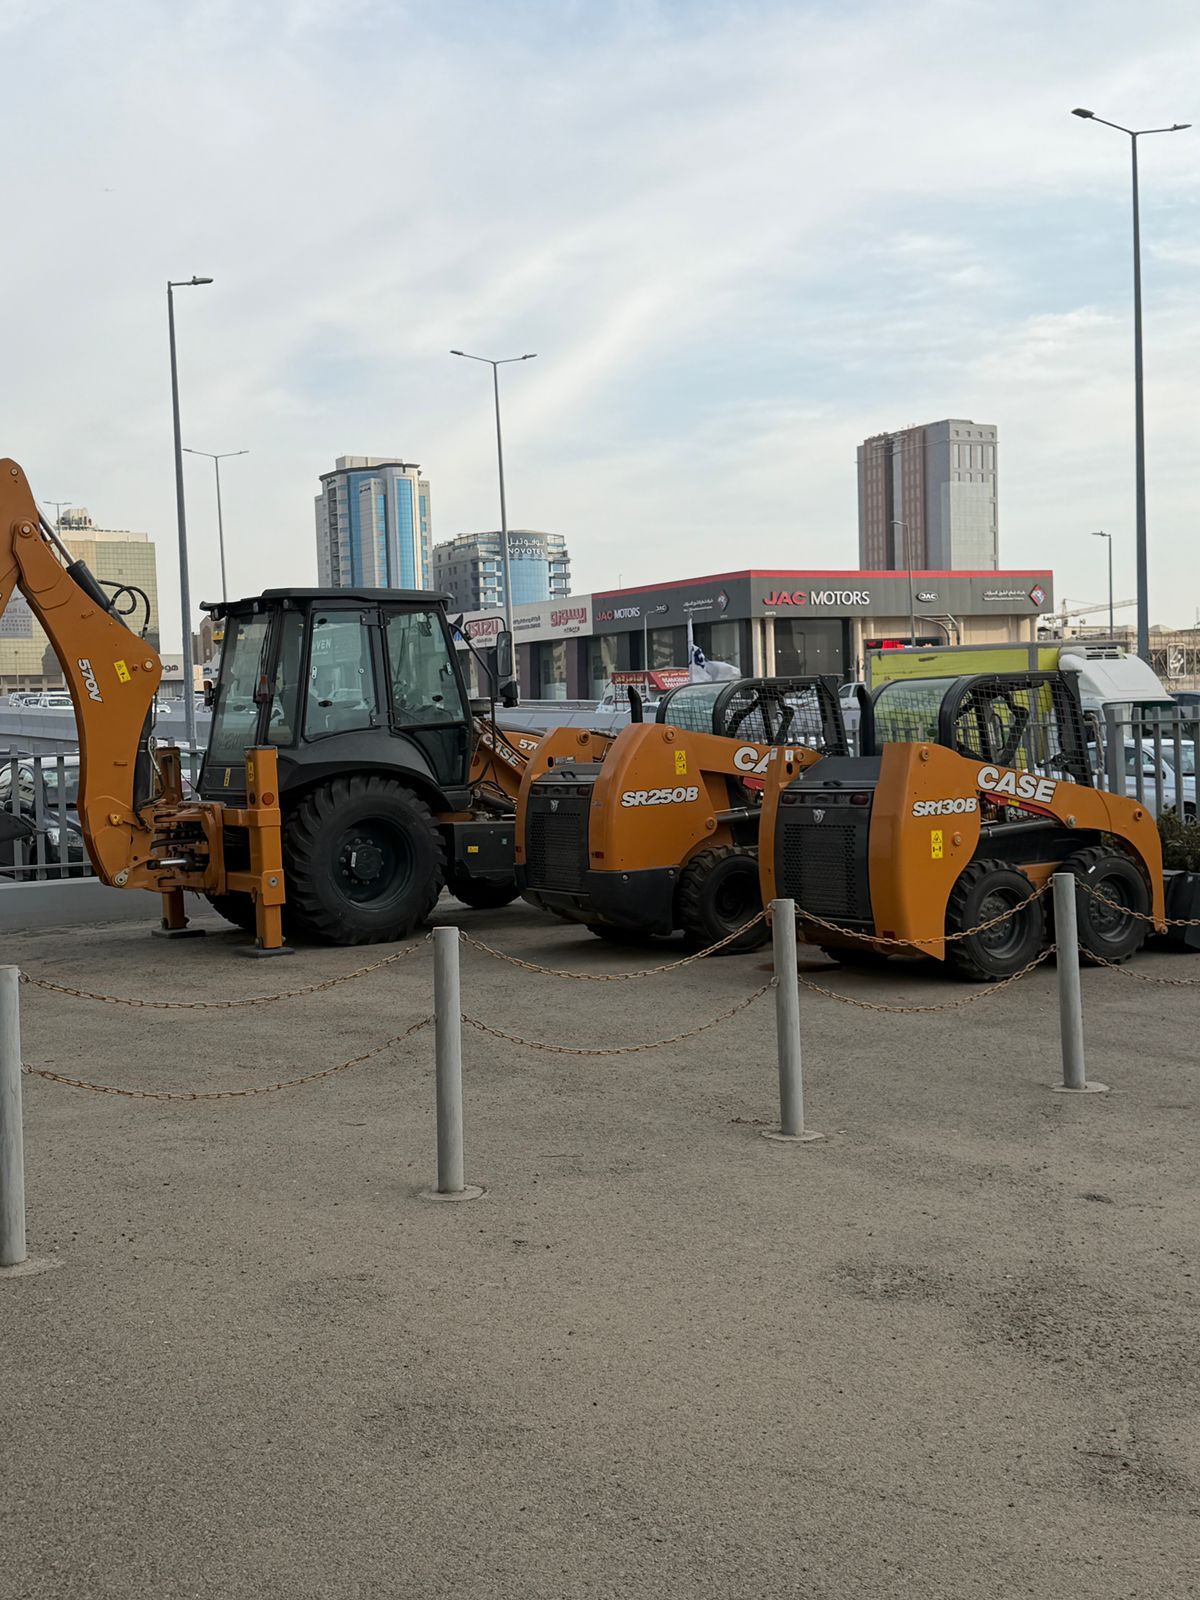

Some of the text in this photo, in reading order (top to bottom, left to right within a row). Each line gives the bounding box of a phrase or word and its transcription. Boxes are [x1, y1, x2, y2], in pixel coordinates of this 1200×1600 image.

[508, 547, 546, 555] NOVOTEL
[763, 590, 870, 606] JAC MOTORS
[596, 606, 640, 621] JAC MOTORS
[468, 619, 499, 637] ISUZU
[976, 765, 1057, 804] CASE
[621, 786, 700, 808] SR250B
[912, 797, 977, 817] SR130B
